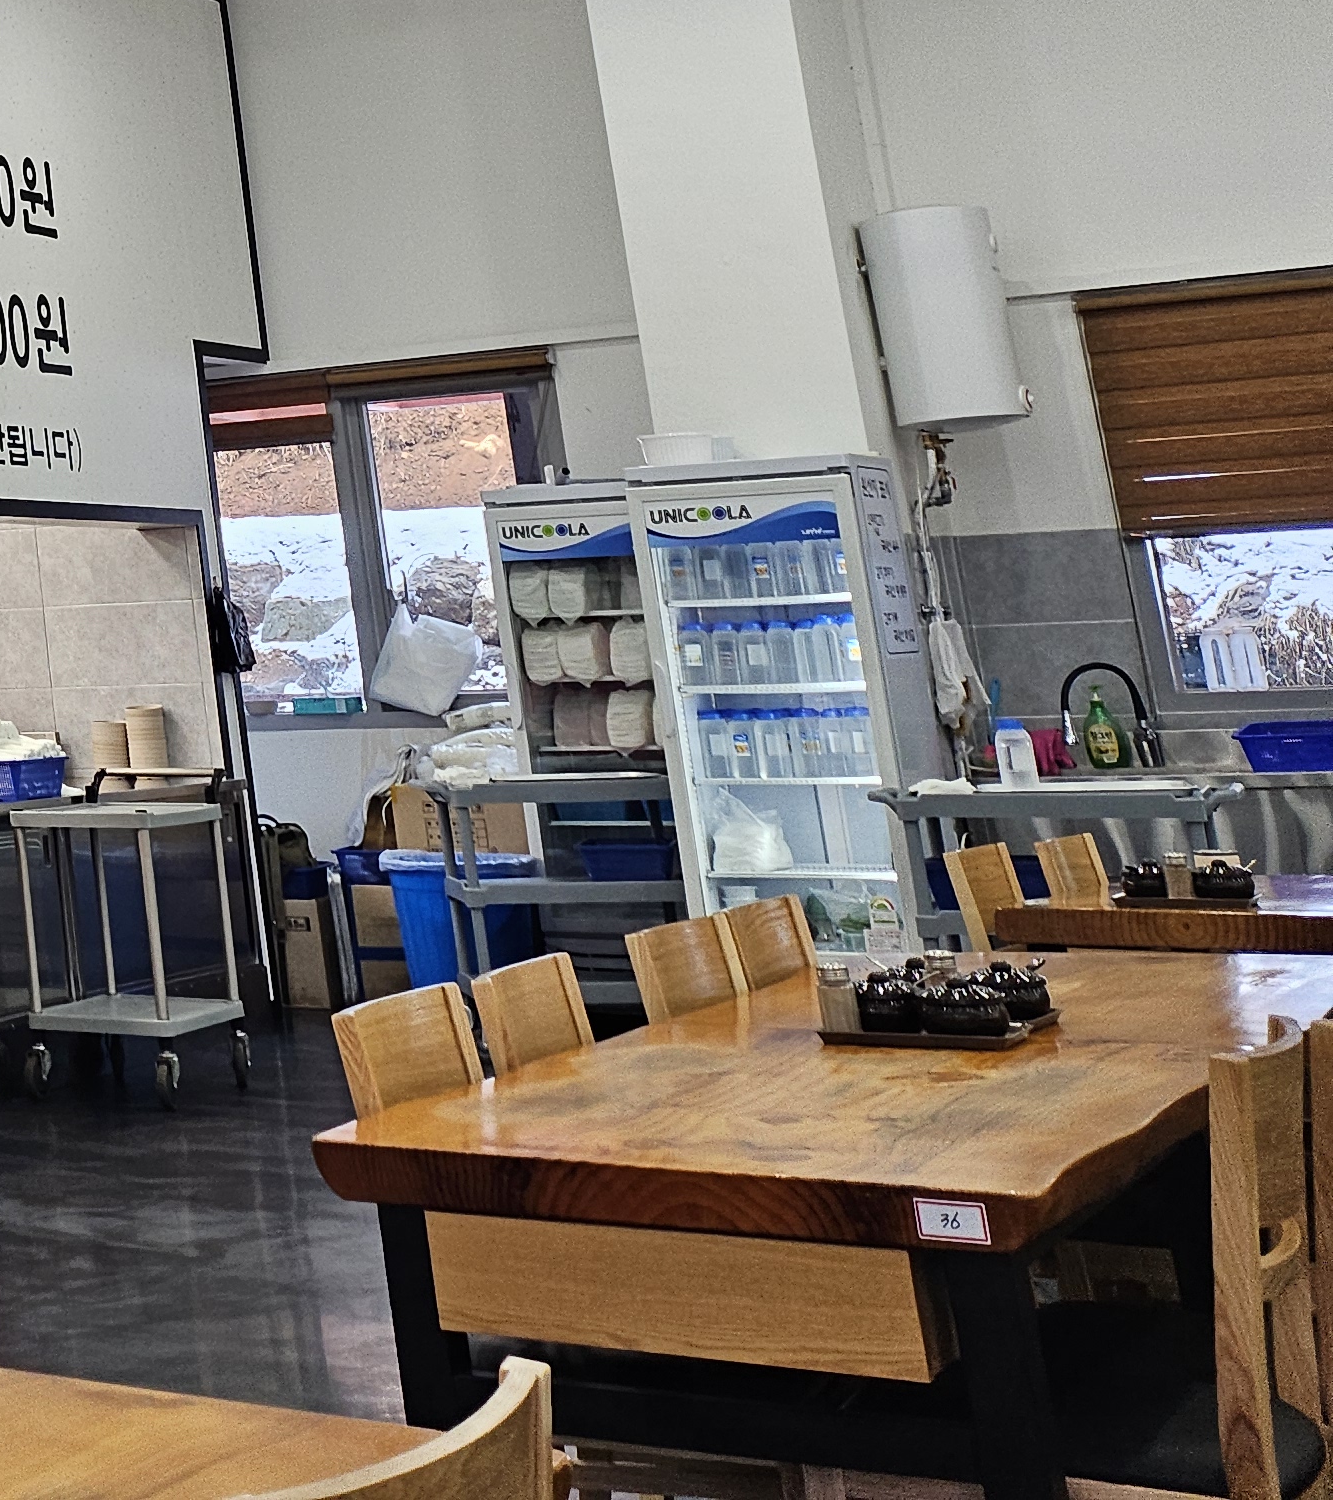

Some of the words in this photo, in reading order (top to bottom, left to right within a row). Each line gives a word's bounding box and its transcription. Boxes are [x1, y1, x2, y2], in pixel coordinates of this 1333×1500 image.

[649, 504, 753, 525] UNICOOLA
[501, 522, 590, 540] UNICOOLA
[940, 1211, 961, 1230] 36
